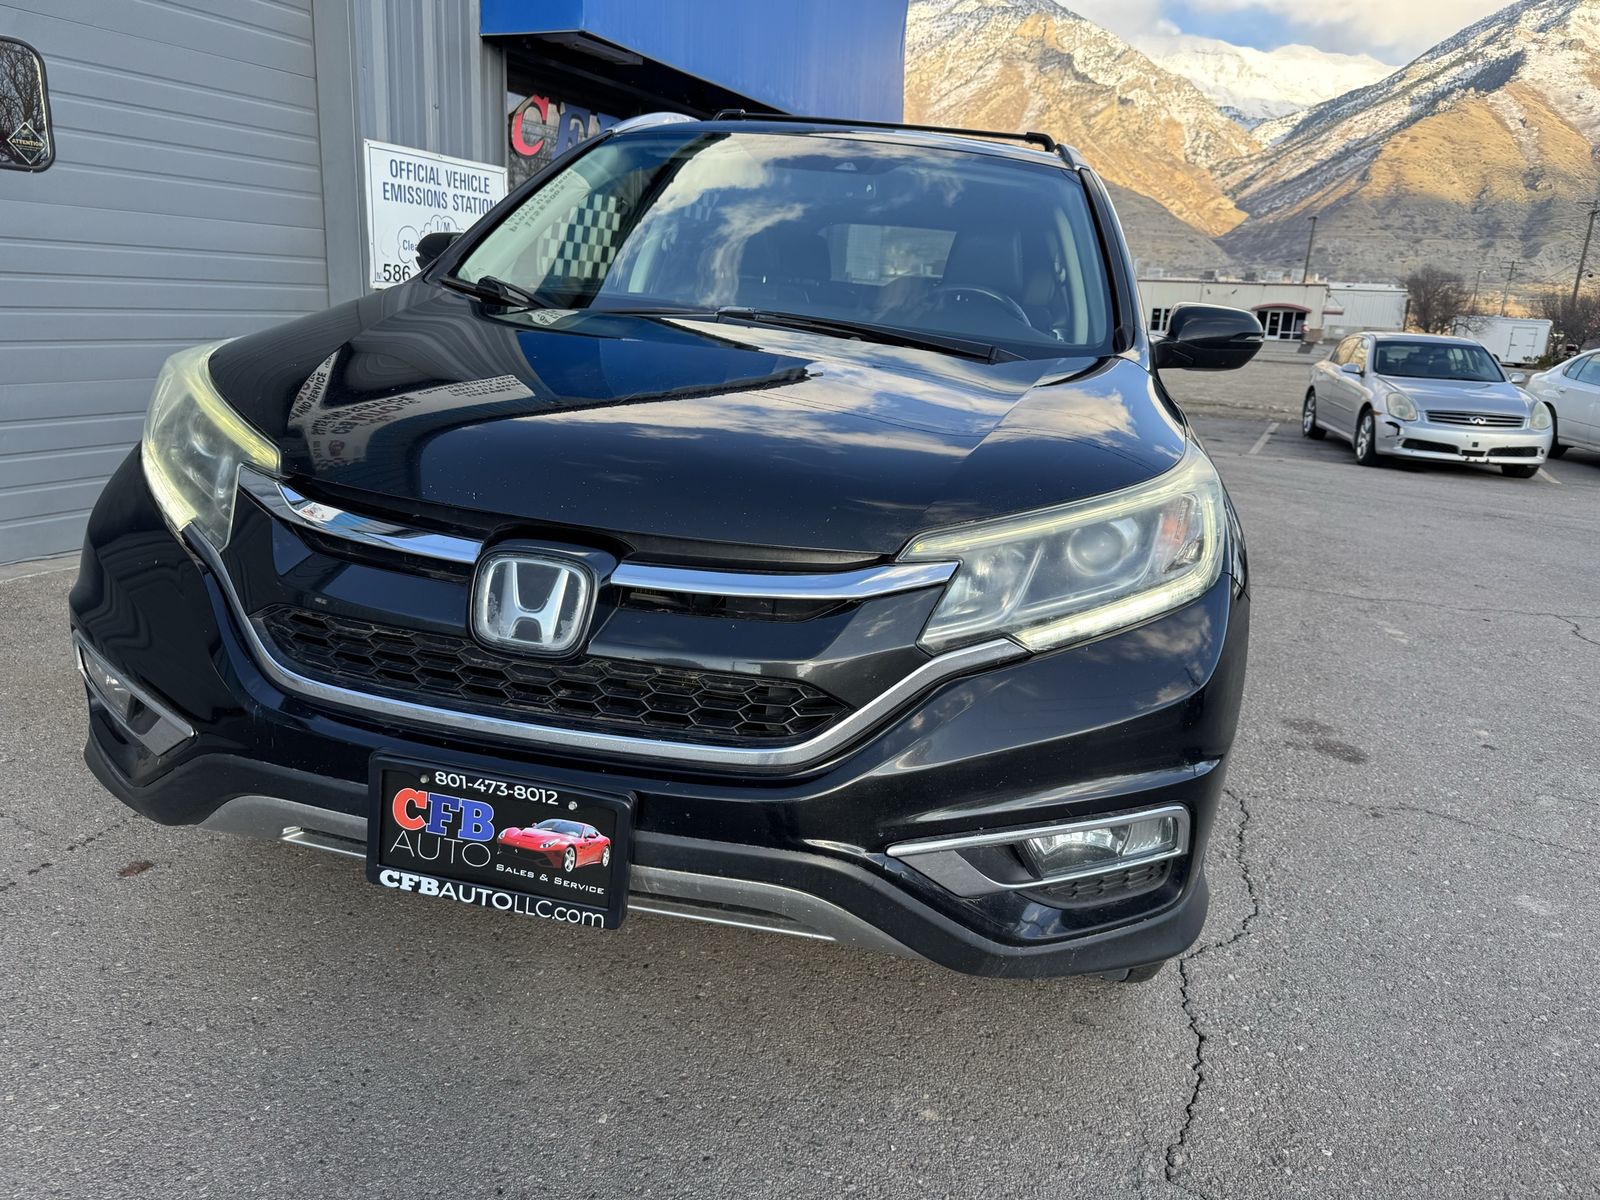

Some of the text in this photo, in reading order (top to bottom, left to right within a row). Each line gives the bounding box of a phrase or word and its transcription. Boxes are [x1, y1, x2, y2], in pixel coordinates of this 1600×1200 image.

[390, 159, 490, 194] OFFICIAL VEHICLE
[382, 181, 448, 210] EMISSIONS
[383, 263, 411, 281] 586
[434, 771, 559, 806] 801-473-8012
[392, 787, 495, 842] CFB
[390, 830, 492, 868] AUTO
[496, 863, 605, 895] SALES & SERVICE
[379, 869, 605, 929] CFBAUTOLLC.com
